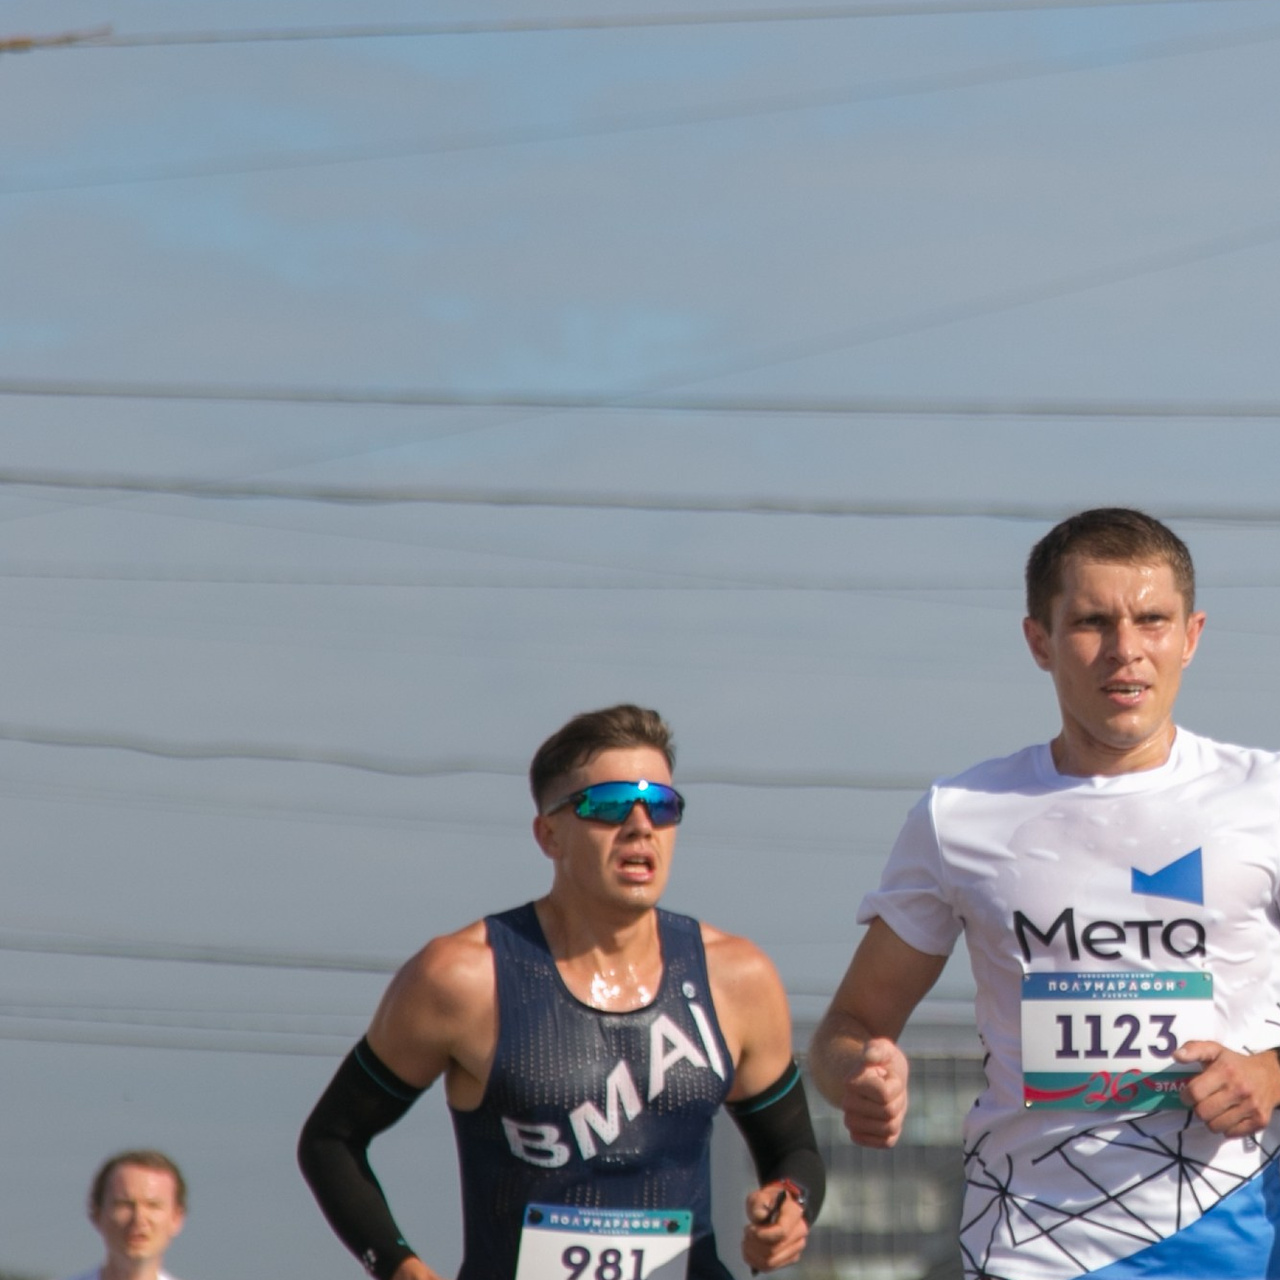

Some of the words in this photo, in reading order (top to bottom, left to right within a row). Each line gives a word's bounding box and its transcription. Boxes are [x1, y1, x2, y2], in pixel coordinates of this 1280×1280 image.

[1013, 907, 1207, 964] Мета
[1048, 981, 1175, 992] ПОЛУМАРАФОН
[1055, 1014, 1179, 1059] 1123
[1154, 1081, 1188, 1093] ЭТАЛ
